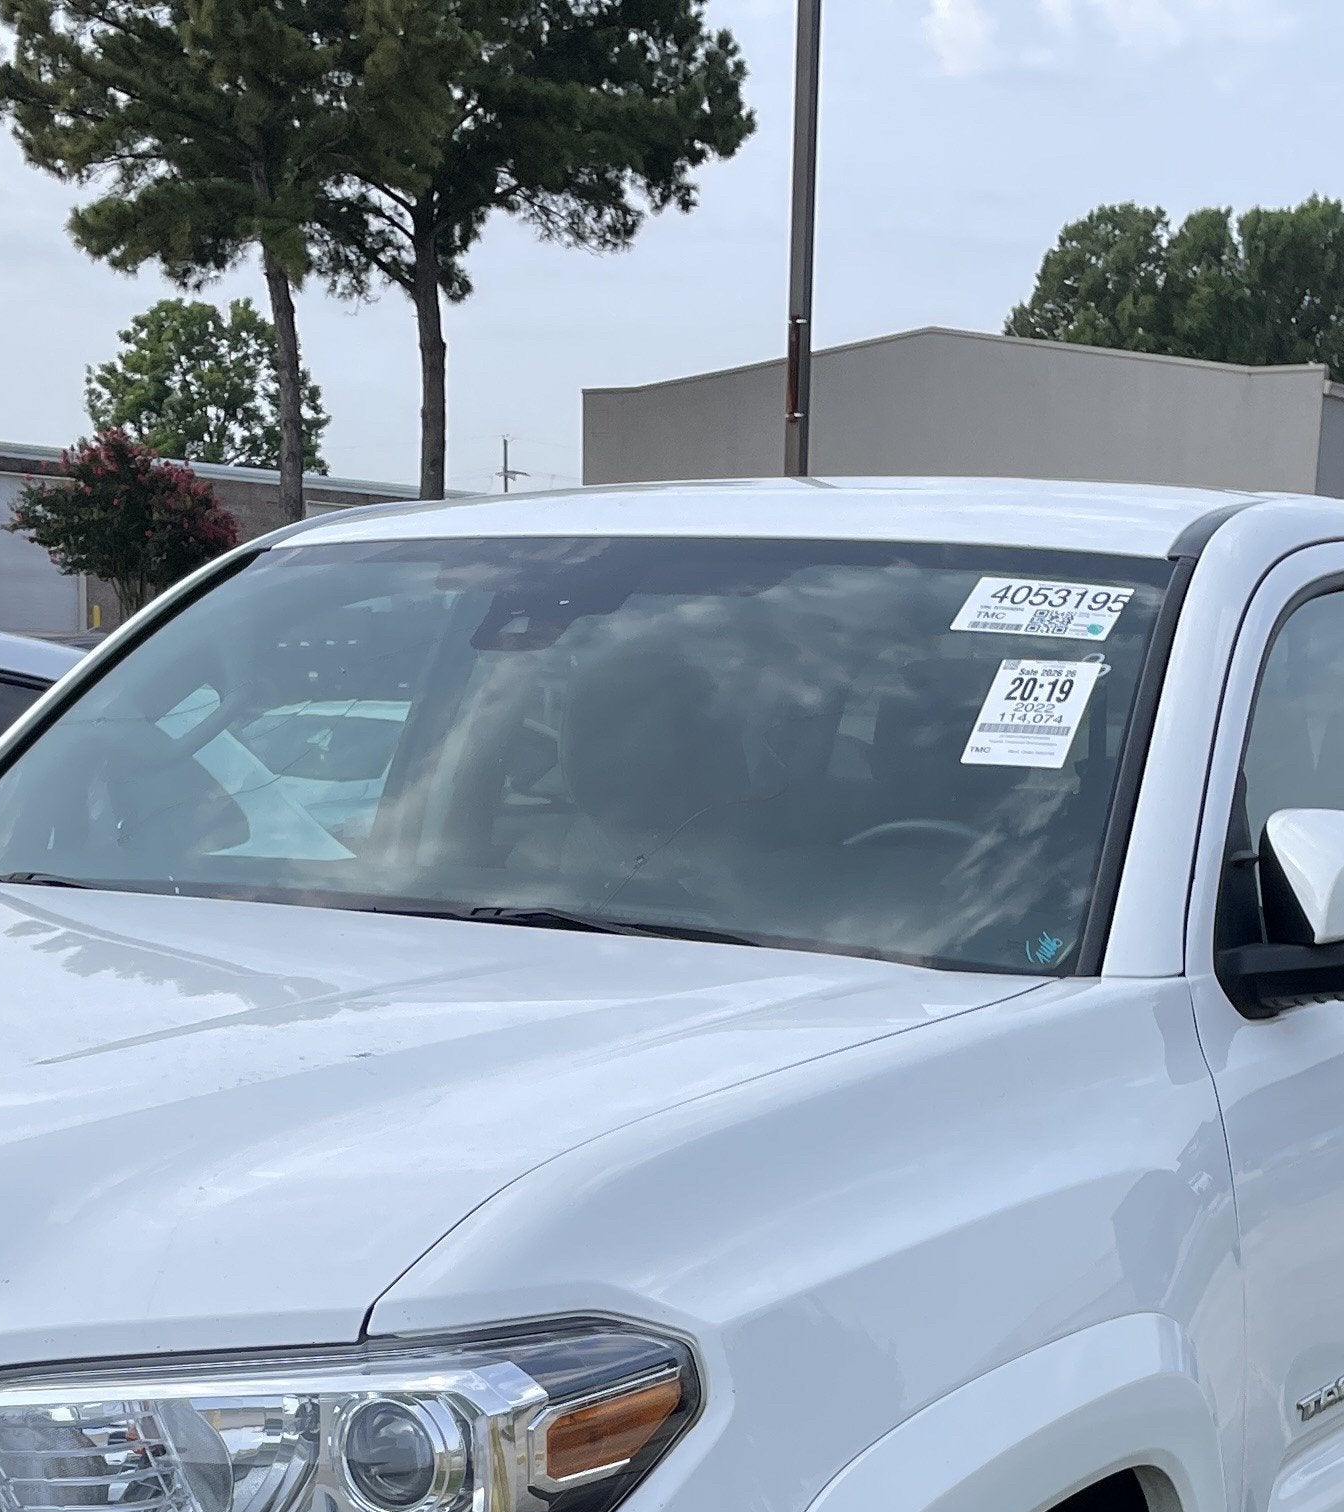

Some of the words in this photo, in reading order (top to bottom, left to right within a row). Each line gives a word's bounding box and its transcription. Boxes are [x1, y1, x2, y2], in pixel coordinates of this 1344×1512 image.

[990, 584, 1132, 613] 4053195
[1004, 677, 1074, 704] 20:19
[1012, 702, 1056, 714] 2022
[998, 712, 1064, 724] 114,074
